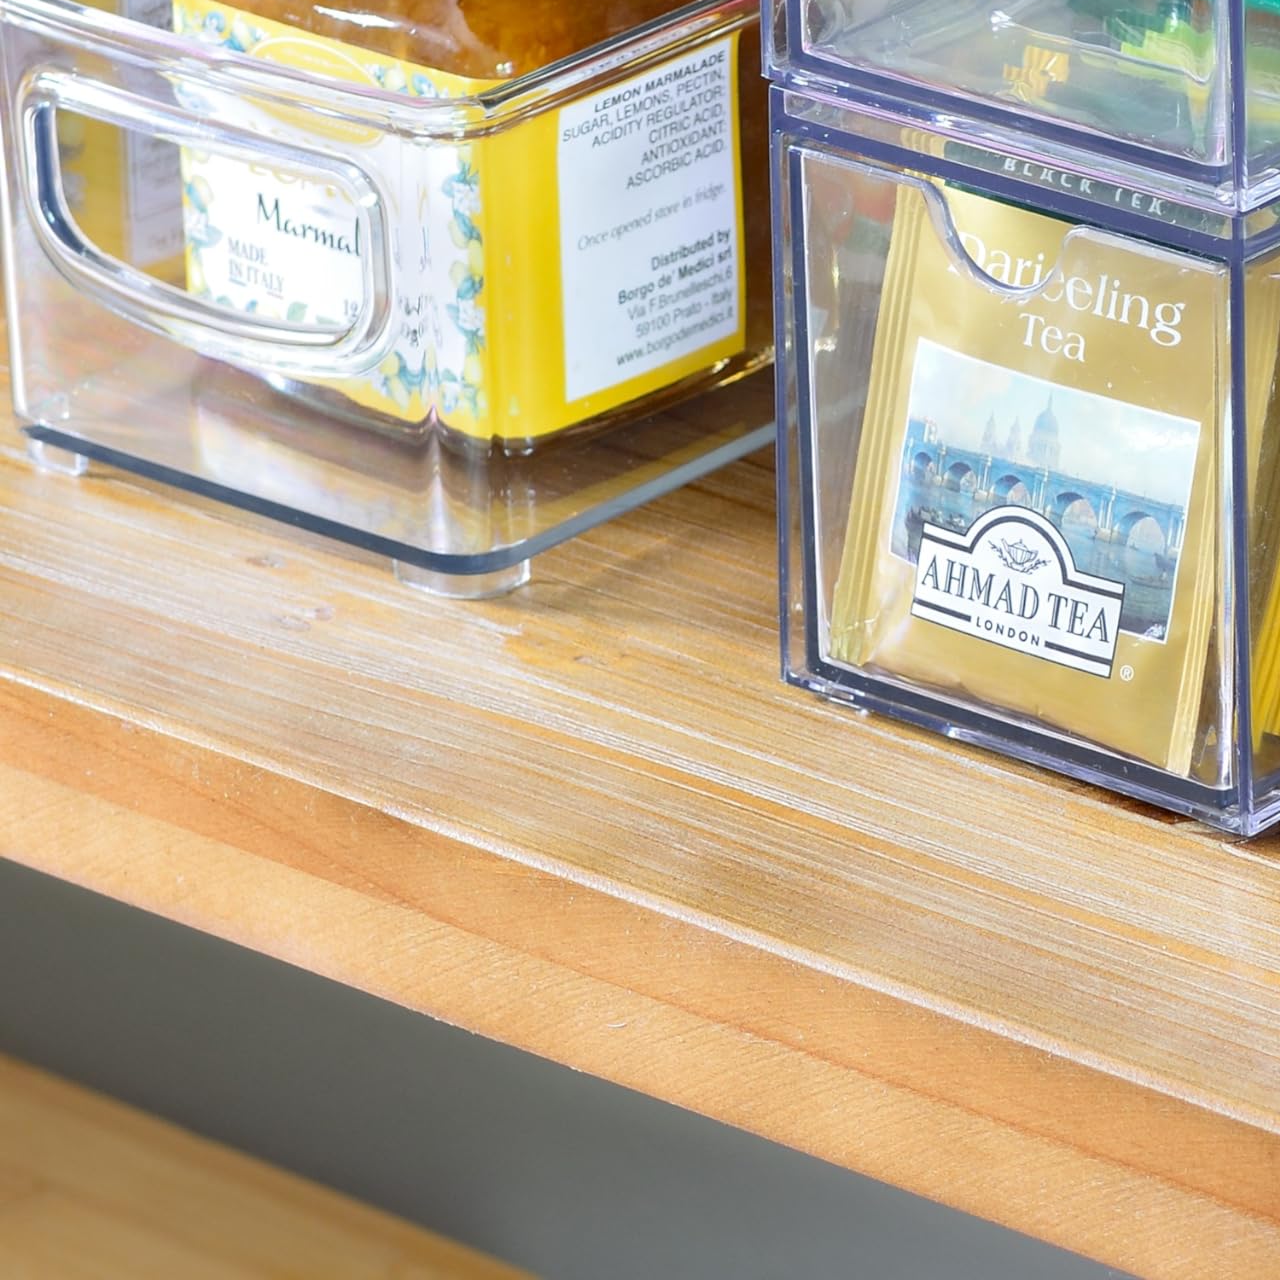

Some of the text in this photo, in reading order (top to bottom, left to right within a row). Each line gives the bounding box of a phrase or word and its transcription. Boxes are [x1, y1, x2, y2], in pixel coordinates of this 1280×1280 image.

[594, 87, 642, 114] LEMON
[645, 50, 726, 94] MARMALADE
[562, 113, 614, 142] SUGAR,
[592, 120, 644, 148] ACIDITY
[649, 117, 692, 144] CITRIC
[626, 151, 694, 190] ASCORBIC
[228, 236, 270, 266] MADE
[651, 228, 732, 272] Distributed by
[228, 258, 284, 296] IN ITALY
[617, 281, 656, 306] Borgo
[677, 256, 716, 282] Medici
[717, 247, 732, 266] srl
[627, 304, 648, 322] Via
[673, 301, 702, 322] Prato
[1019, 312, 1086, 362] Tea
[921, 554, 1110, 644] AHMAD TEA
[976, 616, 1042, 648] LONDON
